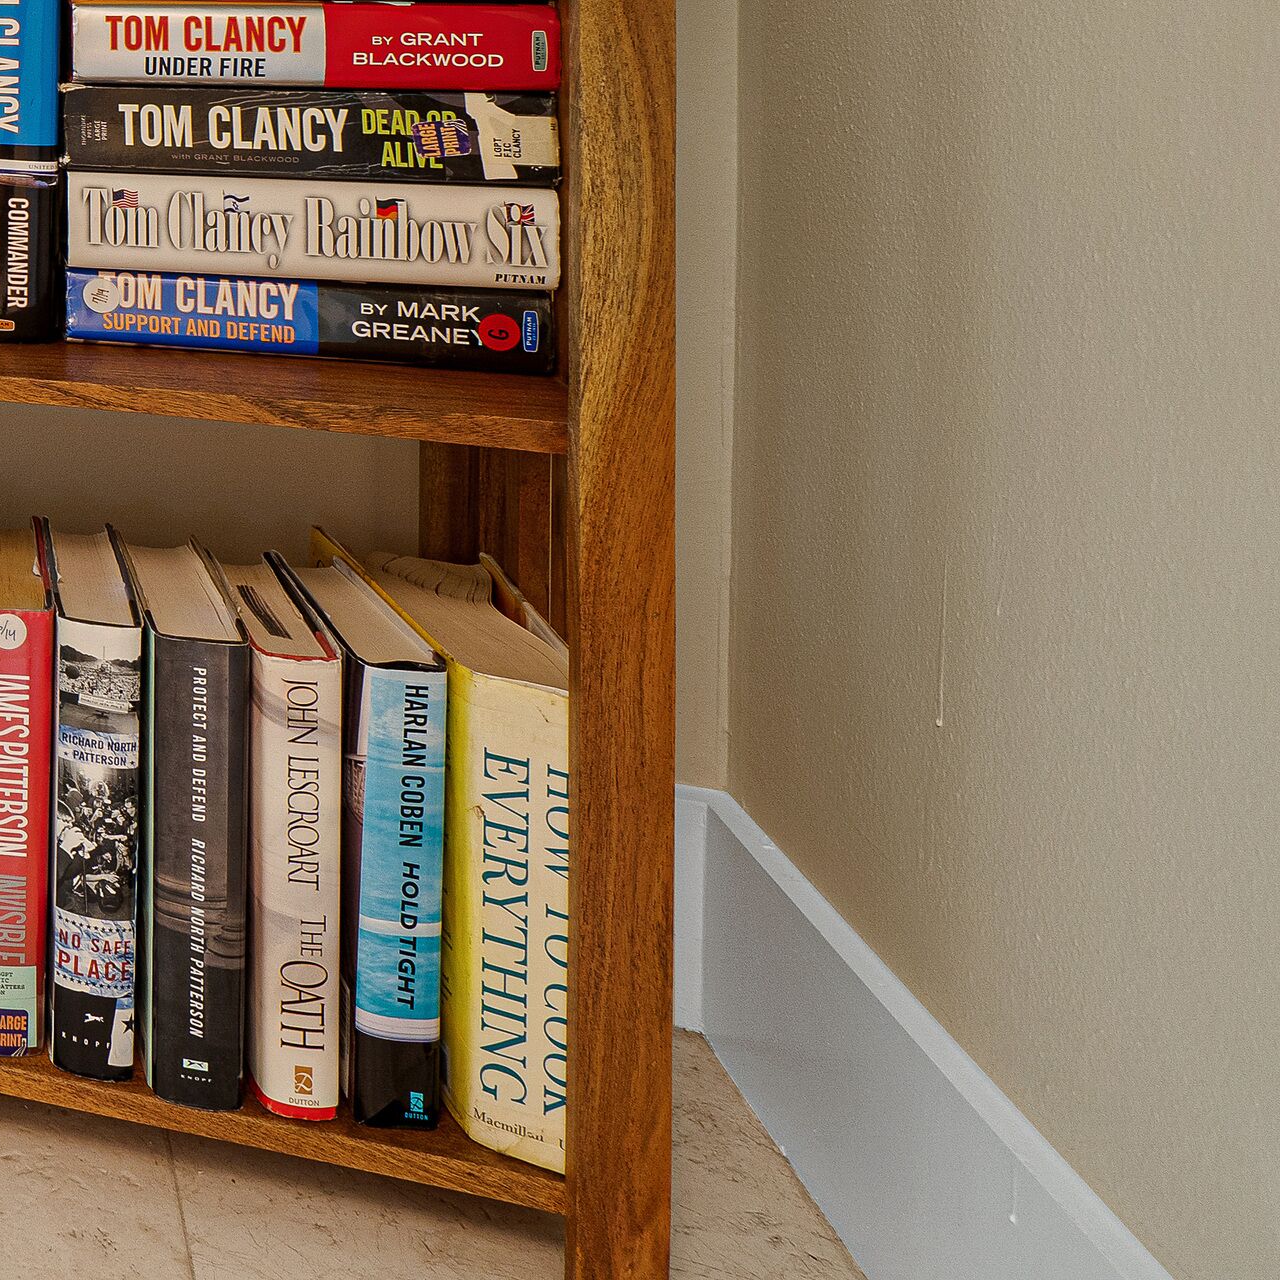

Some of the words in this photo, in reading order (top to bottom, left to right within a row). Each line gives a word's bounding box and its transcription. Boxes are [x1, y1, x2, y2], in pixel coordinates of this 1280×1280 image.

[104, 15, 170, 51] TOM
[184, 16, 306, 53] CLANCY
[372, 35, 392, 46] BY
[400, 32, 483, 46] GRANT
[145, 57, 214, 77] UNDER
[220, 57, 266, 78] FIRE
[352, 51, 504, 68] BLACKWOOD
[118, 104, 193, 148] TOM
[208, 105, 348, 152] CLANCY
[420, 123, 440, 157] LARGE
[513, 128, 521, 158] CLANCY
[233, 155, 300, 163] BLACKWOOD
[494, 138, 502, 157] LGPT
[82, 188, 160, 248] Tom
[168, 191, 294, 270] Clancy
[304, 197, 477, 265] Rainbow
[486, 202, 548, 268] Six
[7, 197, 29, 308] COMMANDER
[176, 275, 299, 320] CLANCY
[495, 274, 546, 284] PUTNAM
[103, 313, 181, 334] SUPPORT
[186, 319, 220, 337] AND
[226, 322, 295, 344] DEFEND
[360, 303, 388, 315] BY
[397, 301, 481, 322] MARK
[193, 667, 207, 730] PROTECT
[281, 678, 318, 746] JOHN
[62, 733, 104, 749] RICHARD
[108, 742, 136, 751] NORTH
[402, 685, 429, 767] HARLAN
[73, 750, 126, 766] PATTERSON
[193, 735, 206, 762] AND
[192, 768, 206, 822] DEFEND
[399, 775, 425, 847] COBEN
[288, 755, 319, 891] LESCROART
[190, 838, 205, 903] RICHARD
[400, 862, 421, 930] HOLD
[59, 928, 80, 948] NO
[91, 939, 131, 955] SAFE
[190, 906, 204, 956] NORTH
[301, 915, 326, 957] THE
[481, 747, 530, 1105] EVERYTHING
[58, 949, 130, 982] PLACE
[397, 936, 417, 1010] TIGHT
[190, 960, 204, 1039] PATTERSON
[280, 960, 328, 1051] OATH
[289, 1097, 320, 1107] DUTTON
[405, 1111, 428, 1120] DUTTON
[473, 1107, 544, 1143] Macmillan
